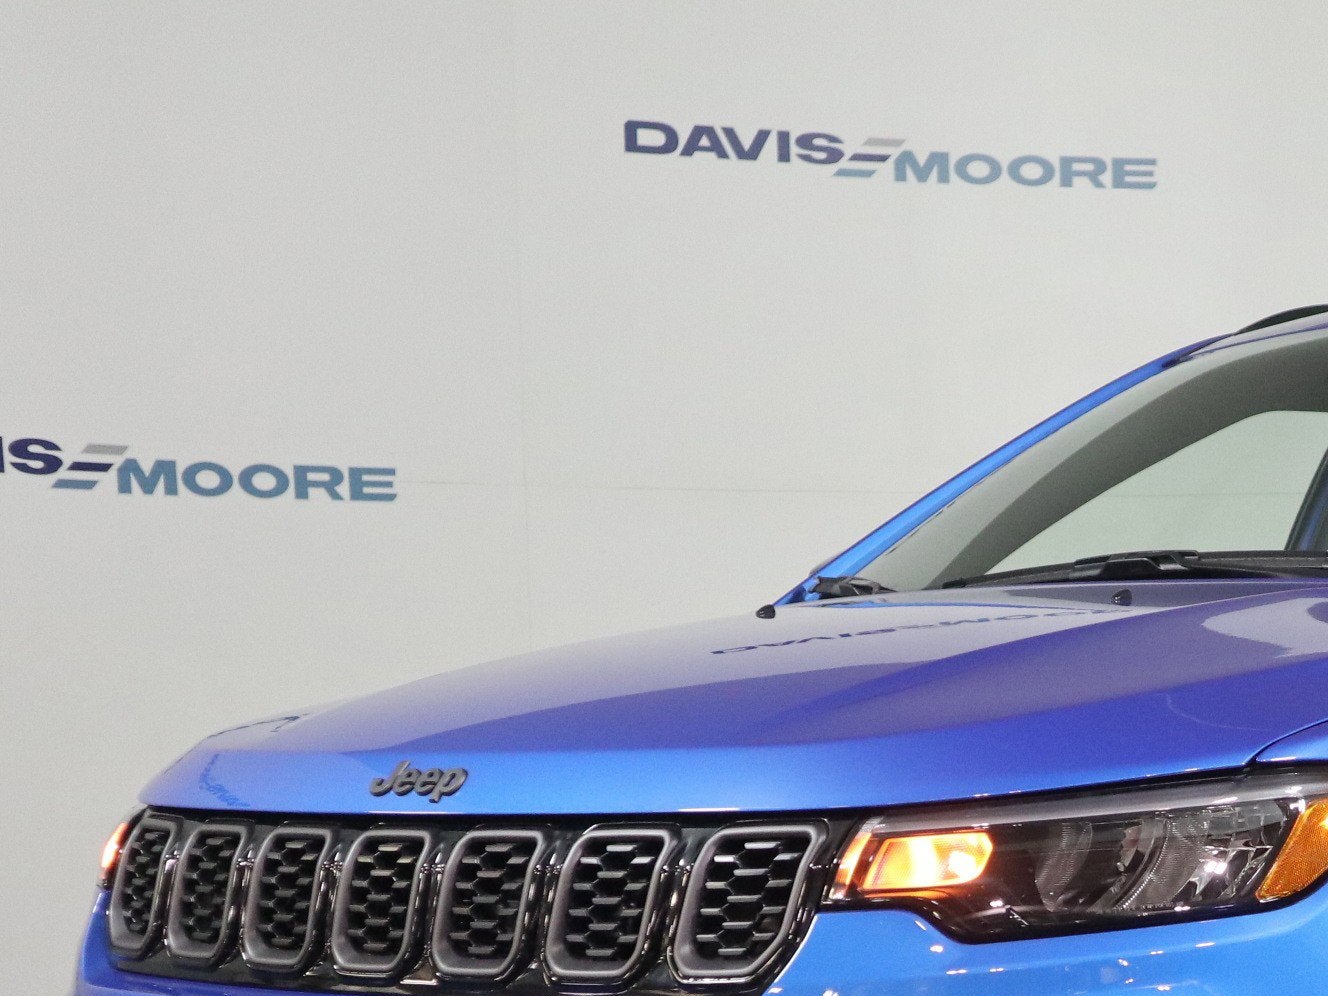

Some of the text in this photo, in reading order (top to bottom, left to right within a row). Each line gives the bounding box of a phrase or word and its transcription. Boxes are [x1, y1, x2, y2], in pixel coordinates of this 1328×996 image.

[624, 119, 1157, 190] DAVIS MOORE
[117, 458, 398, 502] MOORE
[369, 760, 469, 804] Jeep
